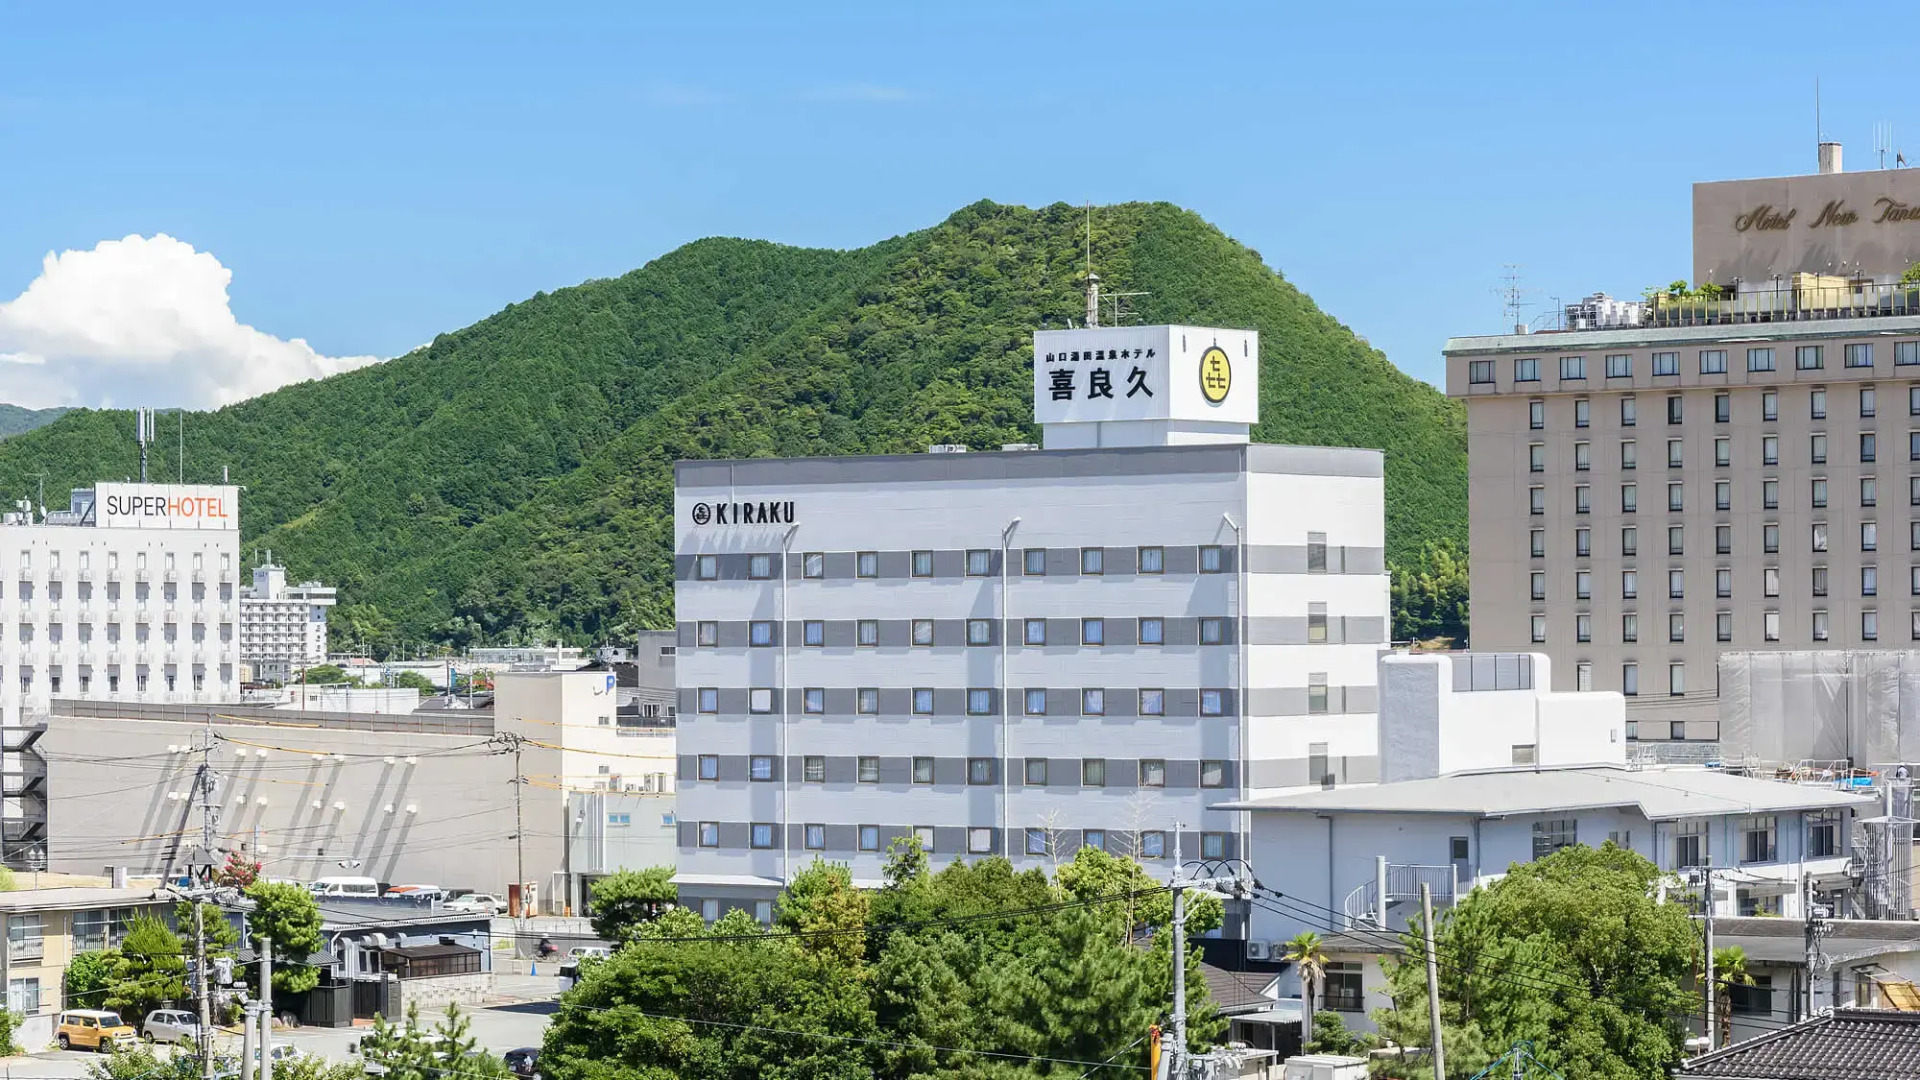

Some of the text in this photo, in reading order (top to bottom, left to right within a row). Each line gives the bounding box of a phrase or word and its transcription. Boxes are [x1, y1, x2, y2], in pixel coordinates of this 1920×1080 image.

[1735, 204, 1796, 232] Hotel
[1808, 200, 1858, 228] New
[1046, 348, 1156, 362] 山口湯田温泉ホテル
[1048, 366, 1154, 401] 喜良久
[716, 501, 795, 525] KIRAKU
